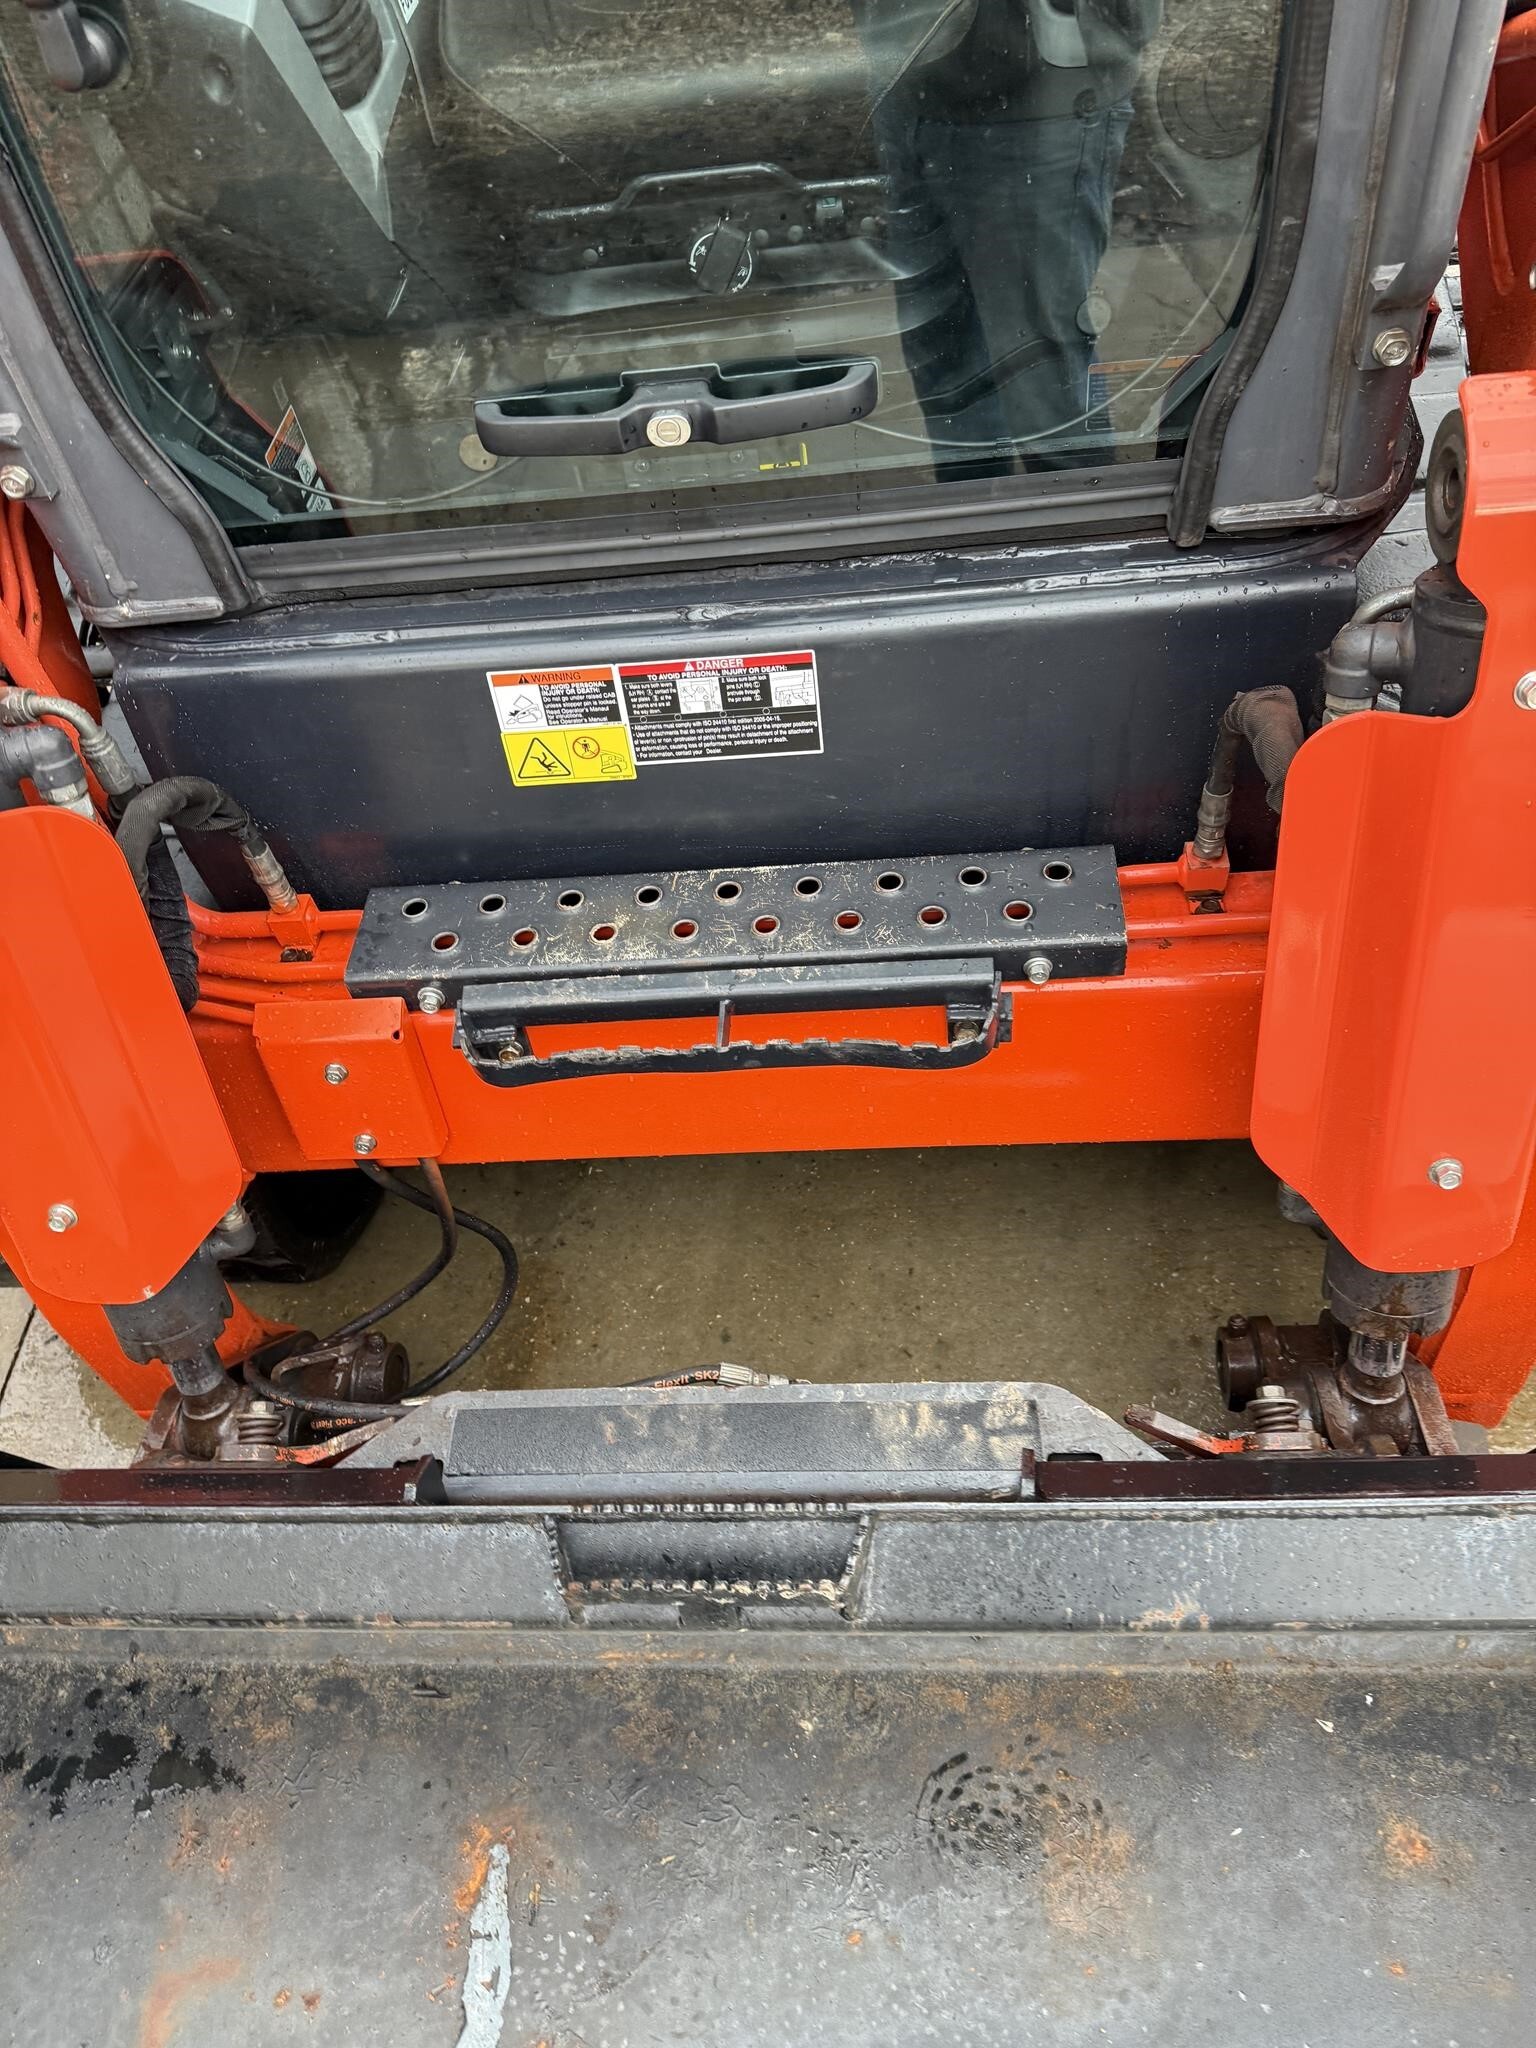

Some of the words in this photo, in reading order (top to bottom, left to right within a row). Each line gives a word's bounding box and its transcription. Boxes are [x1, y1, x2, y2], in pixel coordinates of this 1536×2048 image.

[696, 658, 744, 671] DANGER
[659, 672, 680, 680] AVOID
[682, 669, 720, 678] PERSONAL
[722, 667, 746, 676] INJURY
[761, 664, 788, 673] DEATH:
[532, 672, 580, 682] WARNING
[571, 680, 606, 689] PERSONAL
[576, 686, 601, 694] DEATH:
[792, 719, 817, 728] positioning
